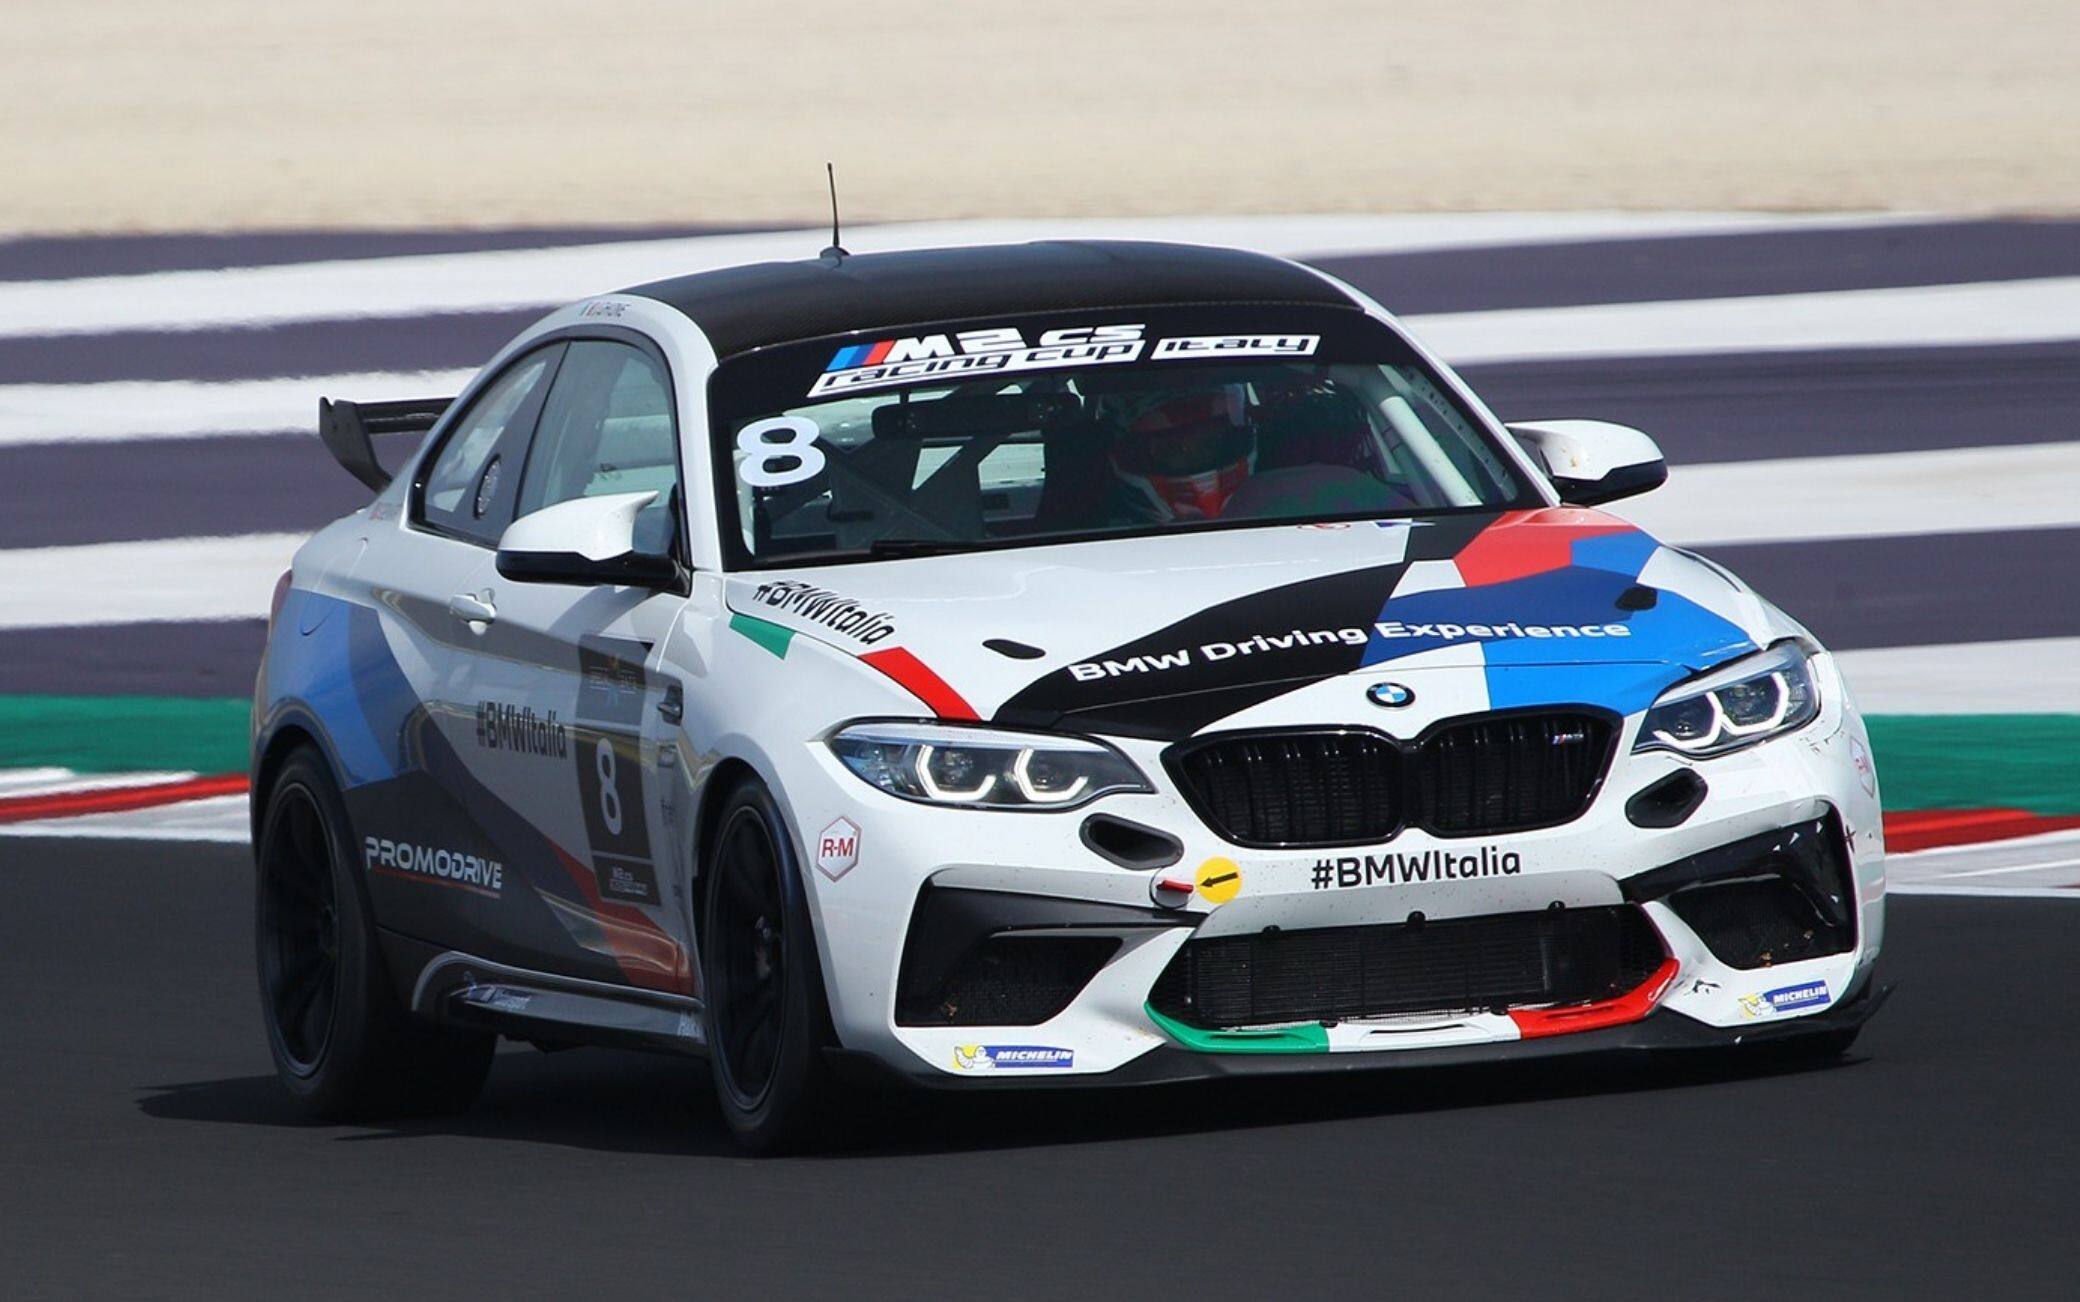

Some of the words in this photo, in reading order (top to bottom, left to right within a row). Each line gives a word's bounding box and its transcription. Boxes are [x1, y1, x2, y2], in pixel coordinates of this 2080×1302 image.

[737, 416, 826, 487] 8
[753, 579, 896, 645] #BMWItalia
[1068, 649, 1191, 682] BMW
[1200, 627, 1369, 662] Driving
[1374, 621, 1632, 640] Experience
[477, 700, 568, 759] #BMWItalia
[597, 737, 623, 835] 8
[365, 836, 503, 889] PROMODRIVE
[1311, 845, 1521, 890] #BMWItalia
[1772, 985, 1828, 1004] MICHELIN
[995, 1050, 1073, 1061] MICHELIN
